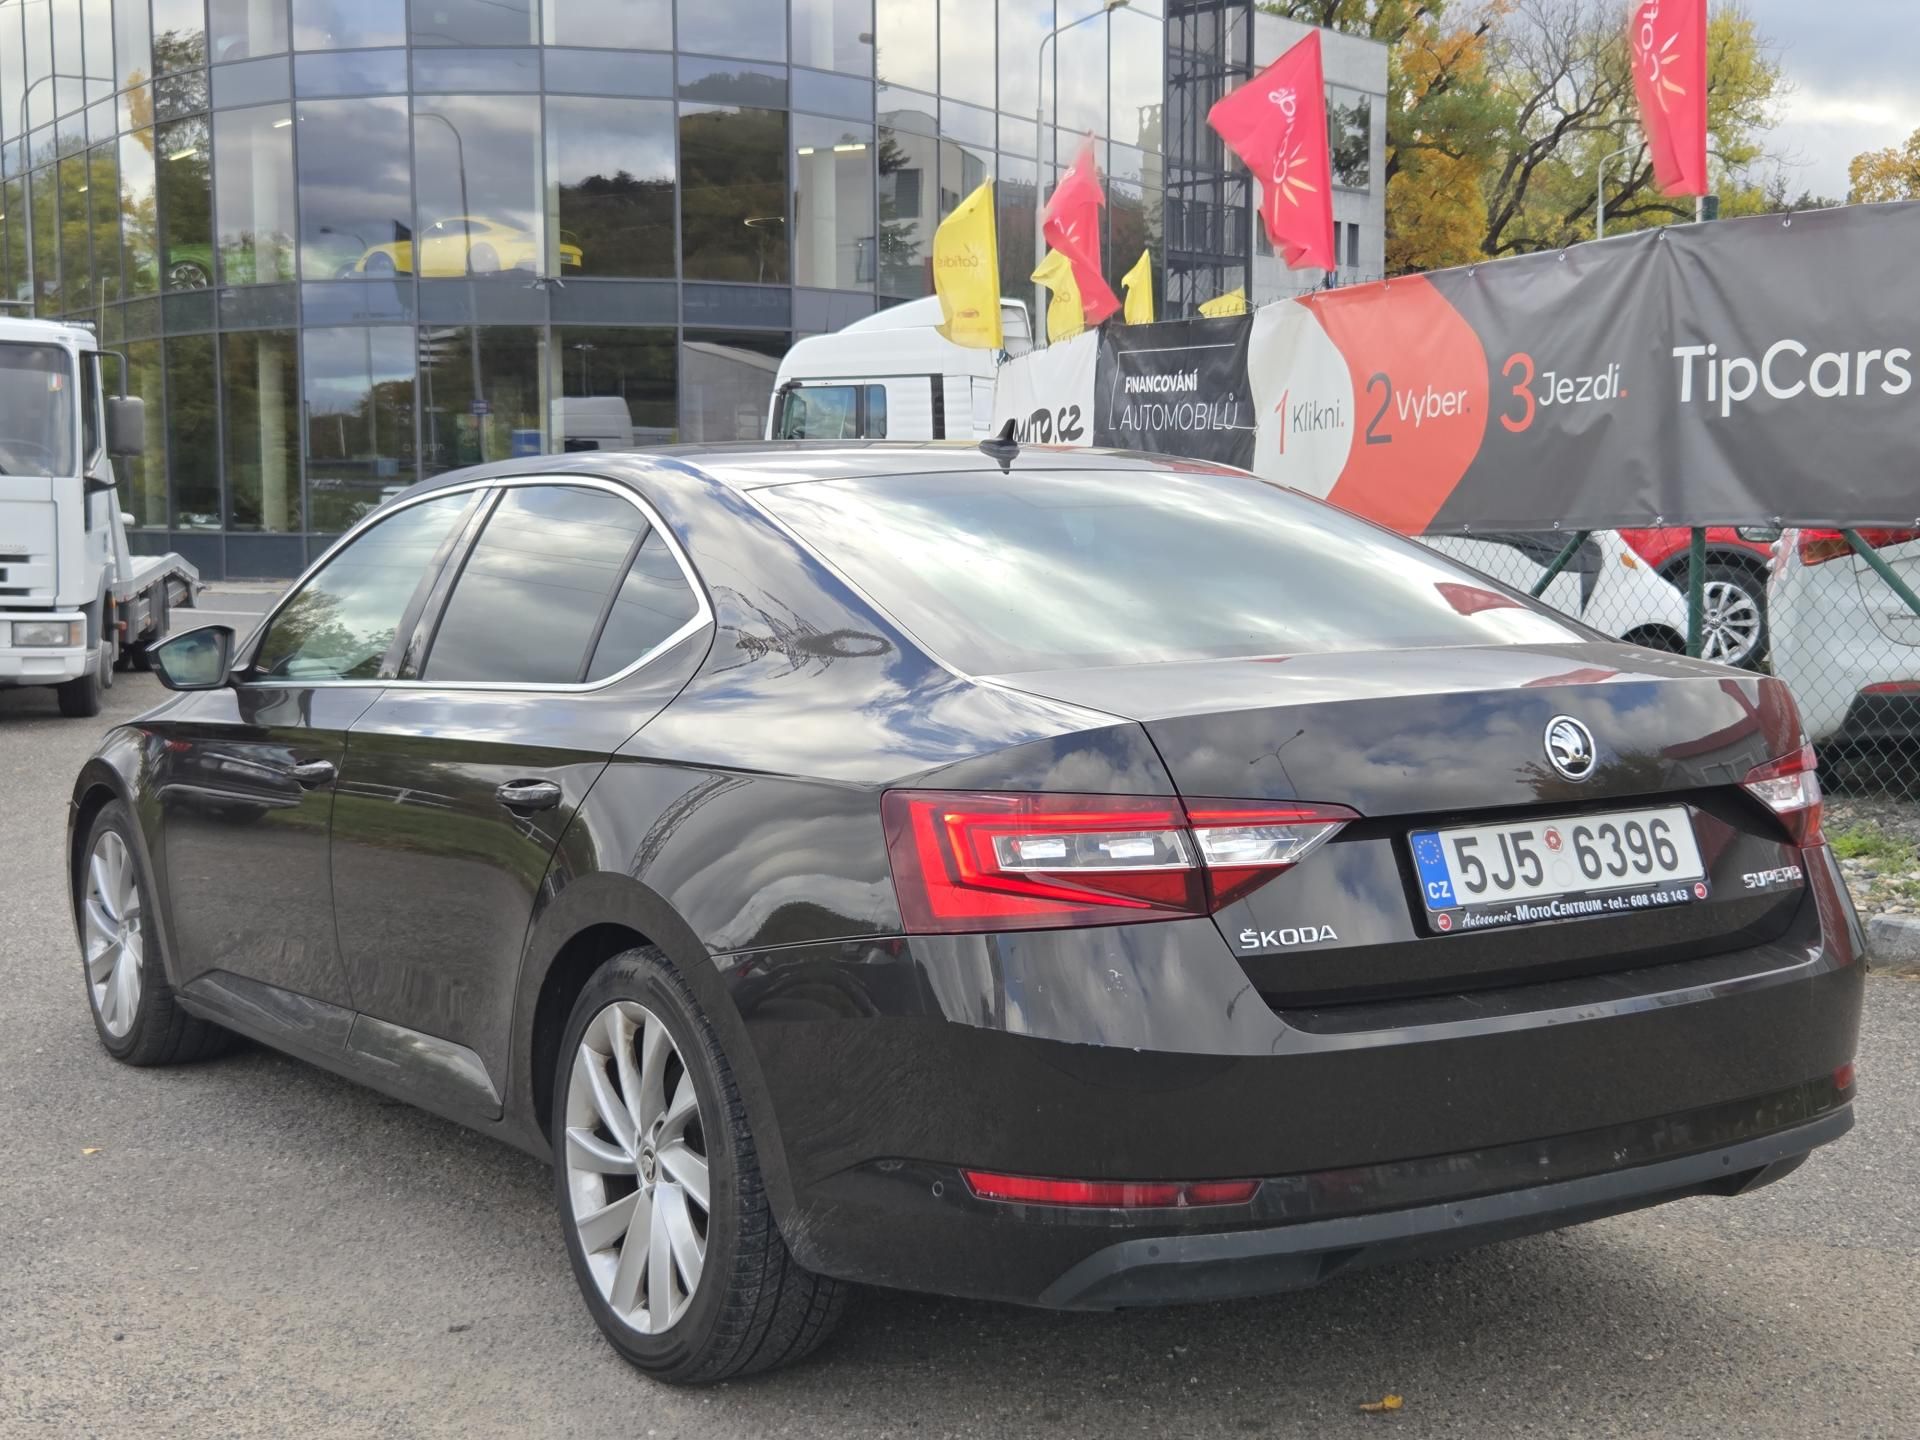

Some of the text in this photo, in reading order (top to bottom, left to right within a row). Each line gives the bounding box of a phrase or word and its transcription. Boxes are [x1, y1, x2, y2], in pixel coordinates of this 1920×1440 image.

[1124, 368, 1199, 394] FINANCOVÁNÍ
[1500, 352, 1629, 433] 3 Jezdi.
[1672, 339, 1913, 417] TipCars
[1120, 393, 1238, 431] AUTOMOBILŮ
[1274, 389, 1345, 455] 1 Klikni.
[1365, 372, 1472, 445] 2 Vyber.
[1452, 818, 1679, 894] 5J5 6396
[1428, 880, 1452, 899] CZ
[1743, 865, 1803, 889] SUPERB
[1630, 894, 1649, 907] 608
[1650, 891, 1668, 904] 143
[1670, 889, 1690, 901] 143
[1240, 924, 1339, 949] ŠKODA
